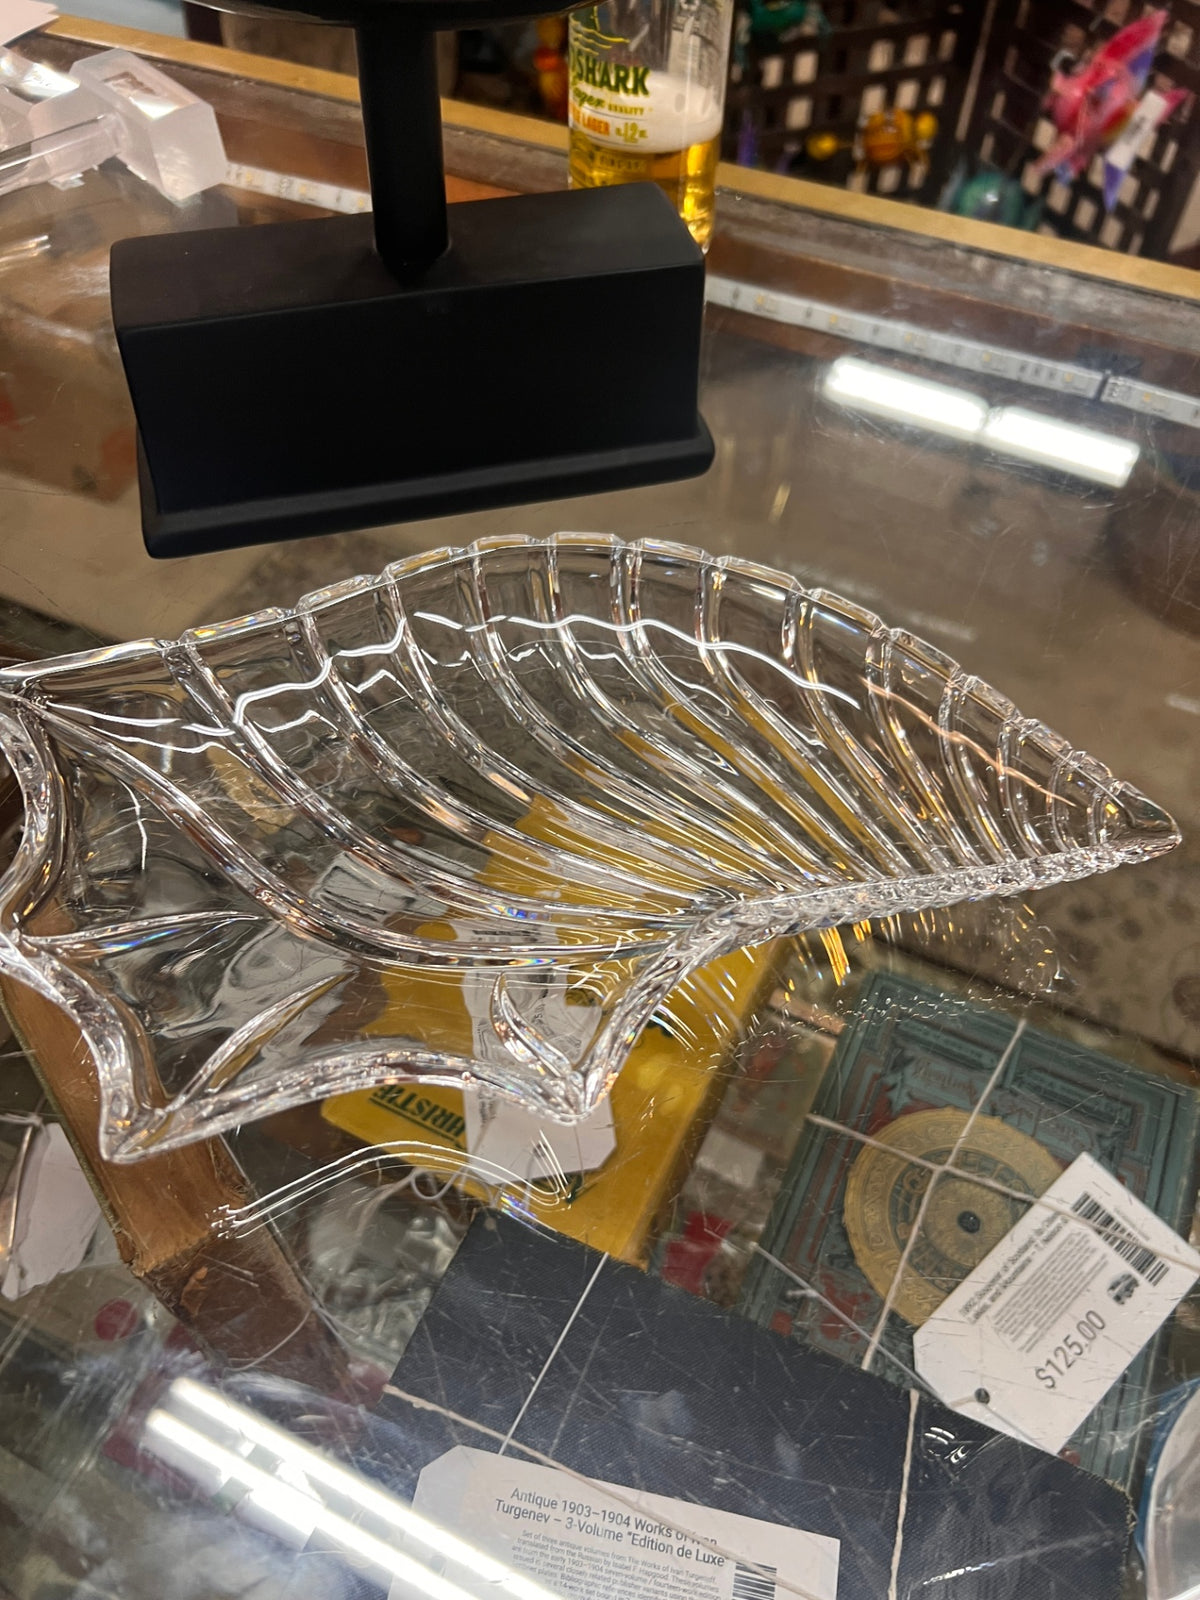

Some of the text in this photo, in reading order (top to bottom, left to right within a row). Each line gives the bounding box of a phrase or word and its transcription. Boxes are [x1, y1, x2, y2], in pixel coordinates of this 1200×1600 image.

[372, 1084, 467, 1137] HRISTIE
[1034, 1310, 1106, 1389] $125.00
[495, 1498, 550, 1525] Turgenev
[565, 1516, 623, 1542] 3-Volume
[676, 1542, 698, 1556] de
[510, 1487, 558, 1511] Antique
[632, 1516, 673, 1538] Works
